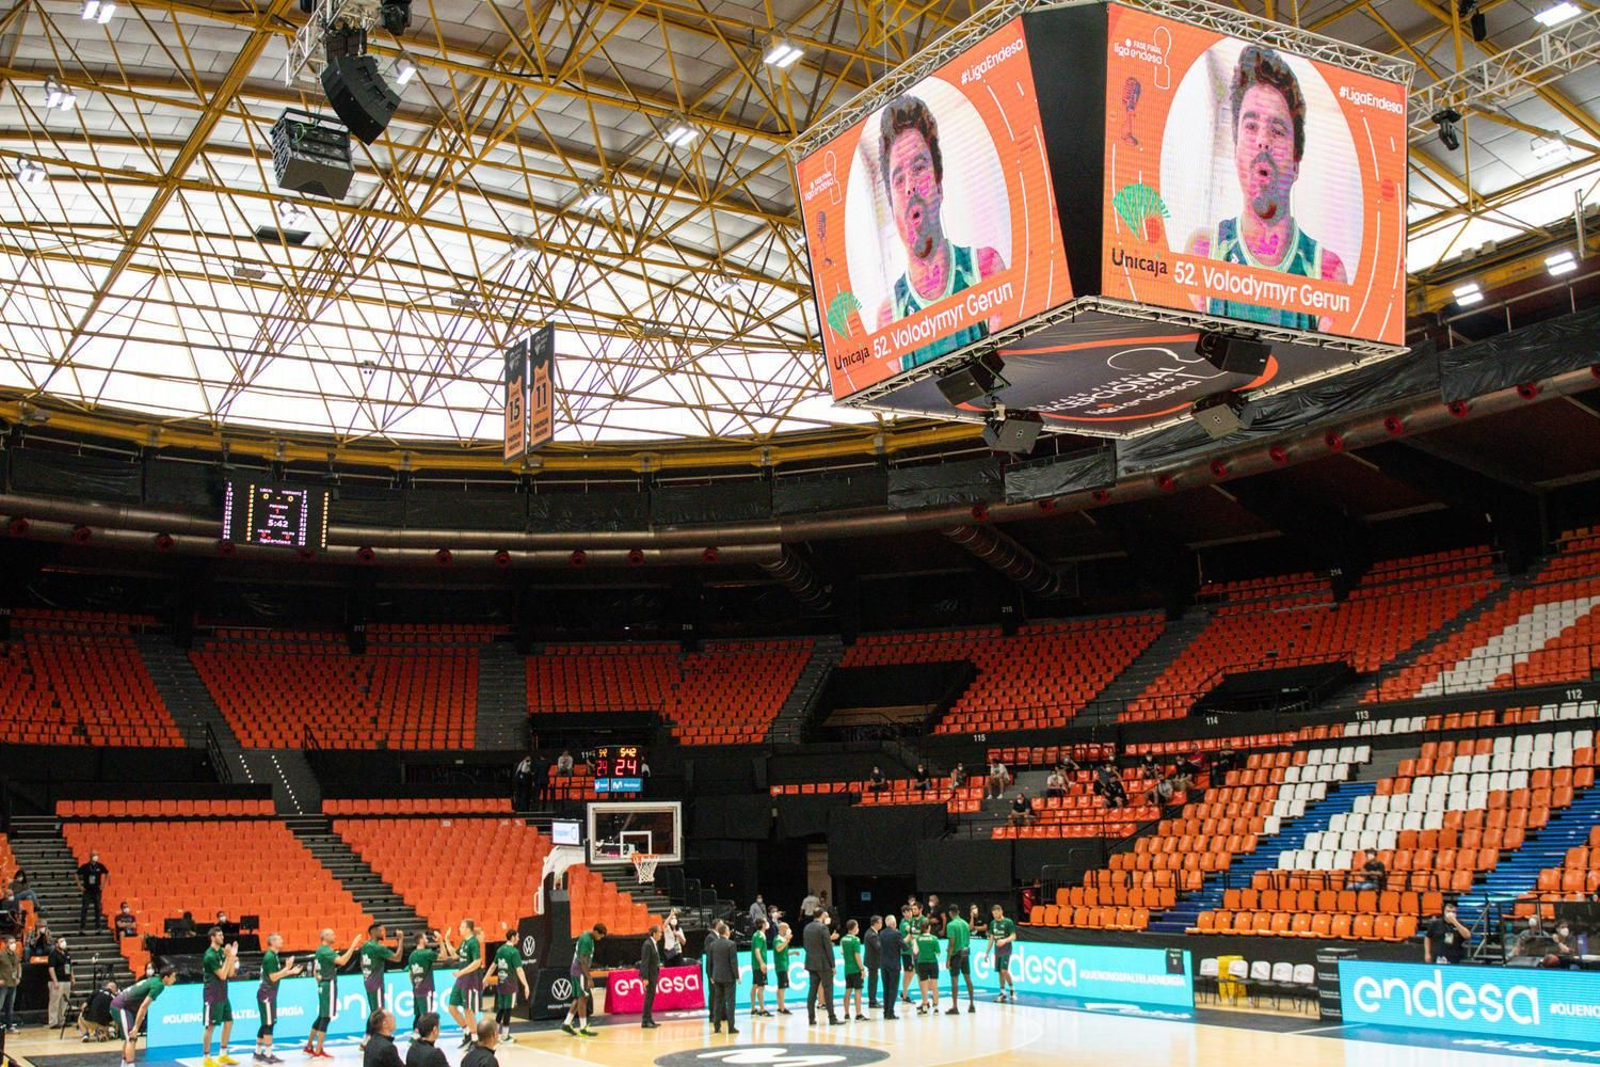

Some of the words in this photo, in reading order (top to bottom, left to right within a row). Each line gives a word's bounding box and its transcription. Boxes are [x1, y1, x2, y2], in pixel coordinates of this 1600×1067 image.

[961, 38, 1024, 86] #LigaEndesa
[1130, 49, 1163, 65] endesa
[1339, 86, 1404, 115] #LigaEndesa
[1112, 247, 1168, 277] Unicaja
[1173, 260, 1199, 287] 52.
[1202, 265, 1298, 307] Volodymyr
[1300, 284, 1350, 313] Gerun
[873, 336, 892, 359] 52.
[890, 303, 965, 350] Volodymyr
[966, 281, 1013, 317] Gerun
[833, 347, 870, 371] Unicaja
[536, 382, 547, 409] 11
[509, 397, 520, 422] 15
[267, 519, 289, 528] 5:42
[1565, 689, 1583, 700] 112
[1206, 716, 1218, 725] 114
[1355, 710, 1369, 720] 113
[973, 733, 986, 742] 115
[597, 760, 608, 776] 24
[615, 759, 637, 776] 24
[614, 974, 700, 997] enesa
[1353, 968, 1540, 1025] endesa
